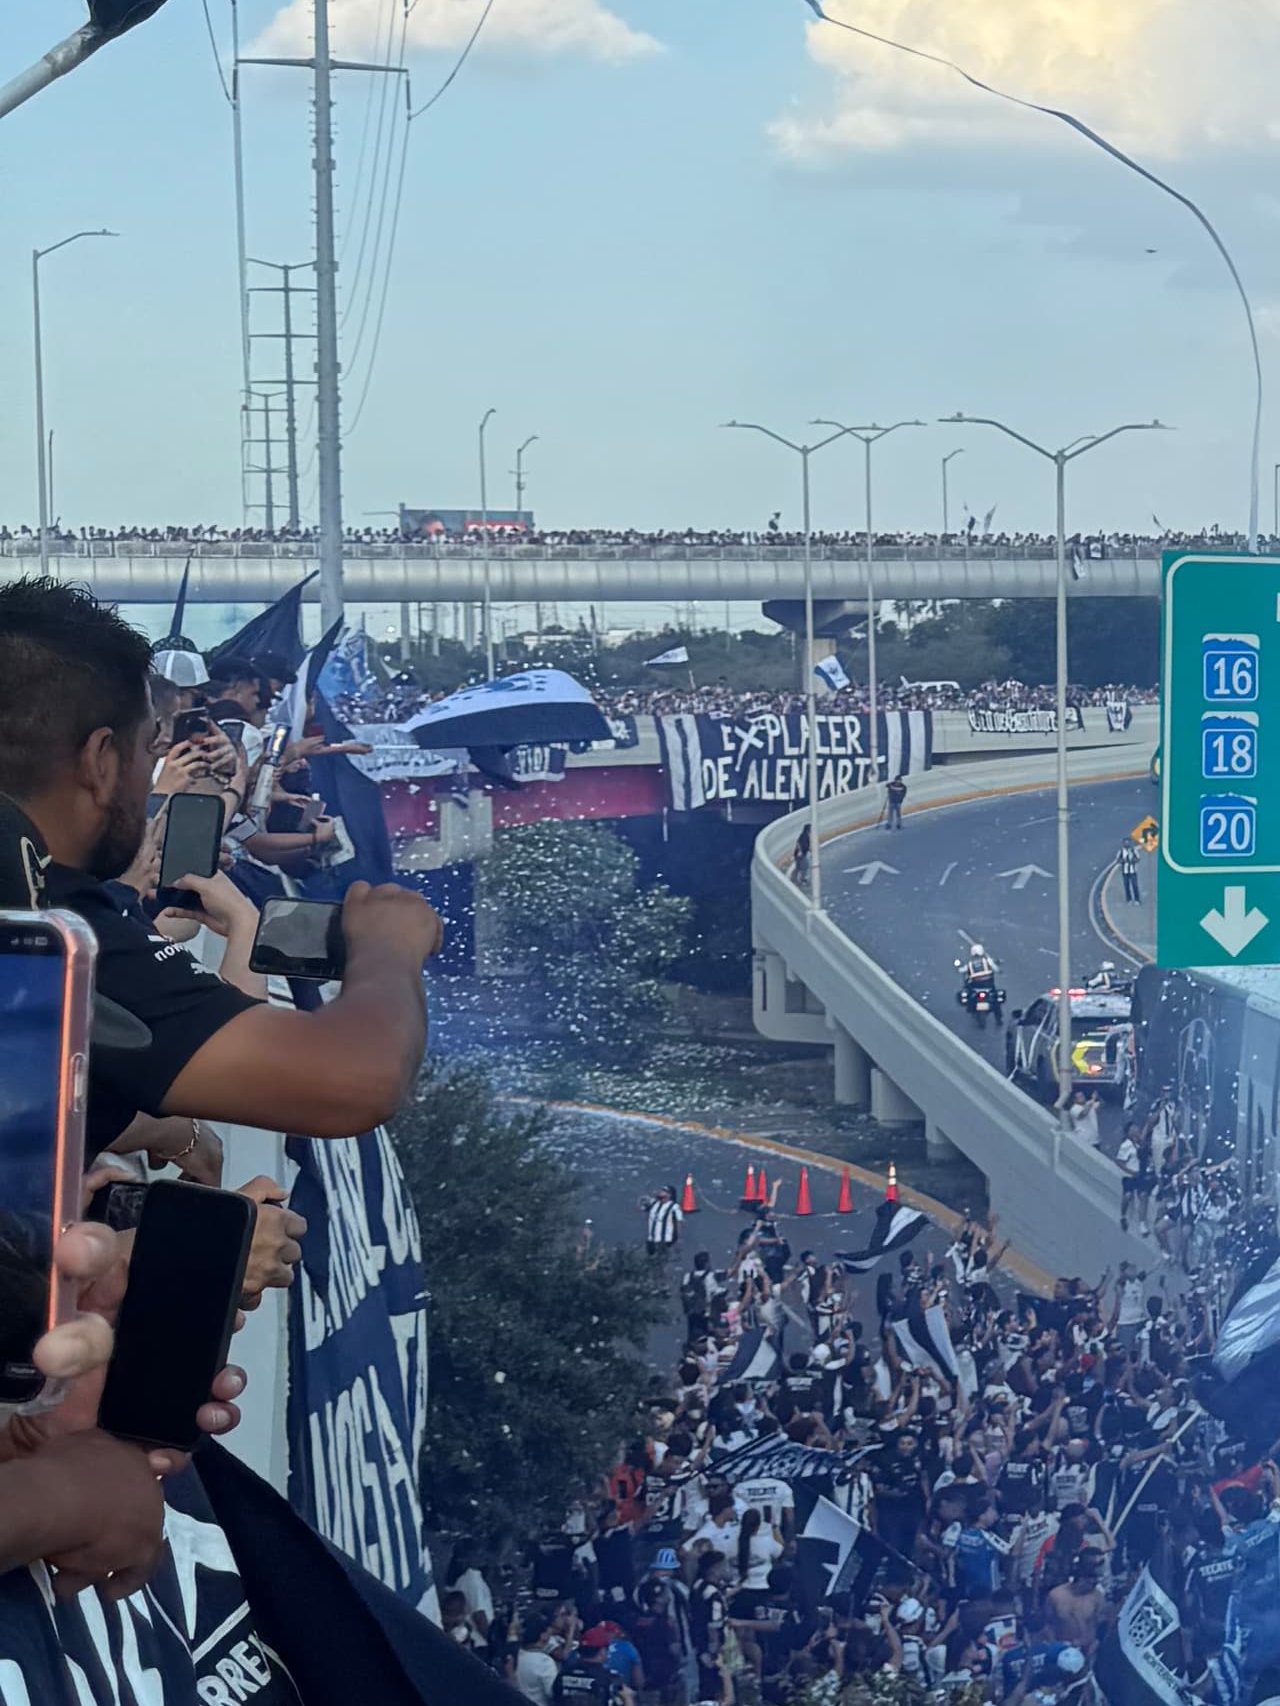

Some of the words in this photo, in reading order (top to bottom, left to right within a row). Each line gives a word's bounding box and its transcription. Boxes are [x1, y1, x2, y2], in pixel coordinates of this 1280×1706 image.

[1212, 657, 1253, 696] 16
[1211, 734, 1252, 774] 18
[702, 756, 737, 800] DE
[1206, 812, 1251, 851] 20
